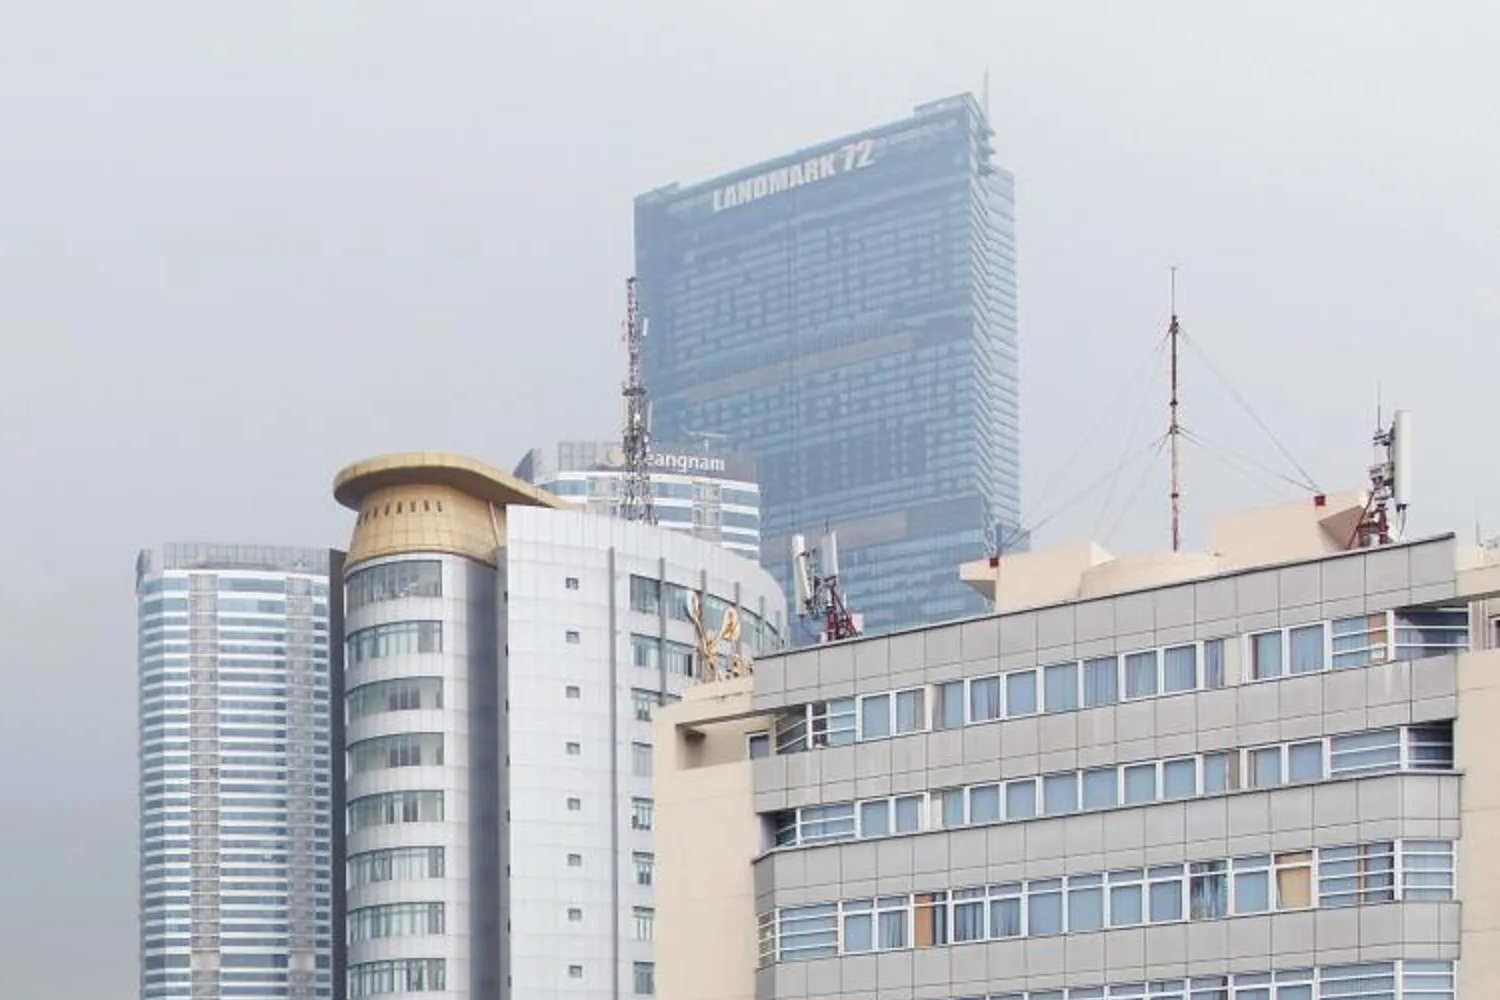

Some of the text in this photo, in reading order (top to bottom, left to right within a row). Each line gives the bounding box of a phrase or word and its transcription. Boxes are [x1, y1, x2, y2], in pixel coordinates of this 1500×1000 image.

[712, 152, 836, 213] LANDMARK
[841, 138, 876, 172] 72
[632, 449, 725, 473] eangnam
